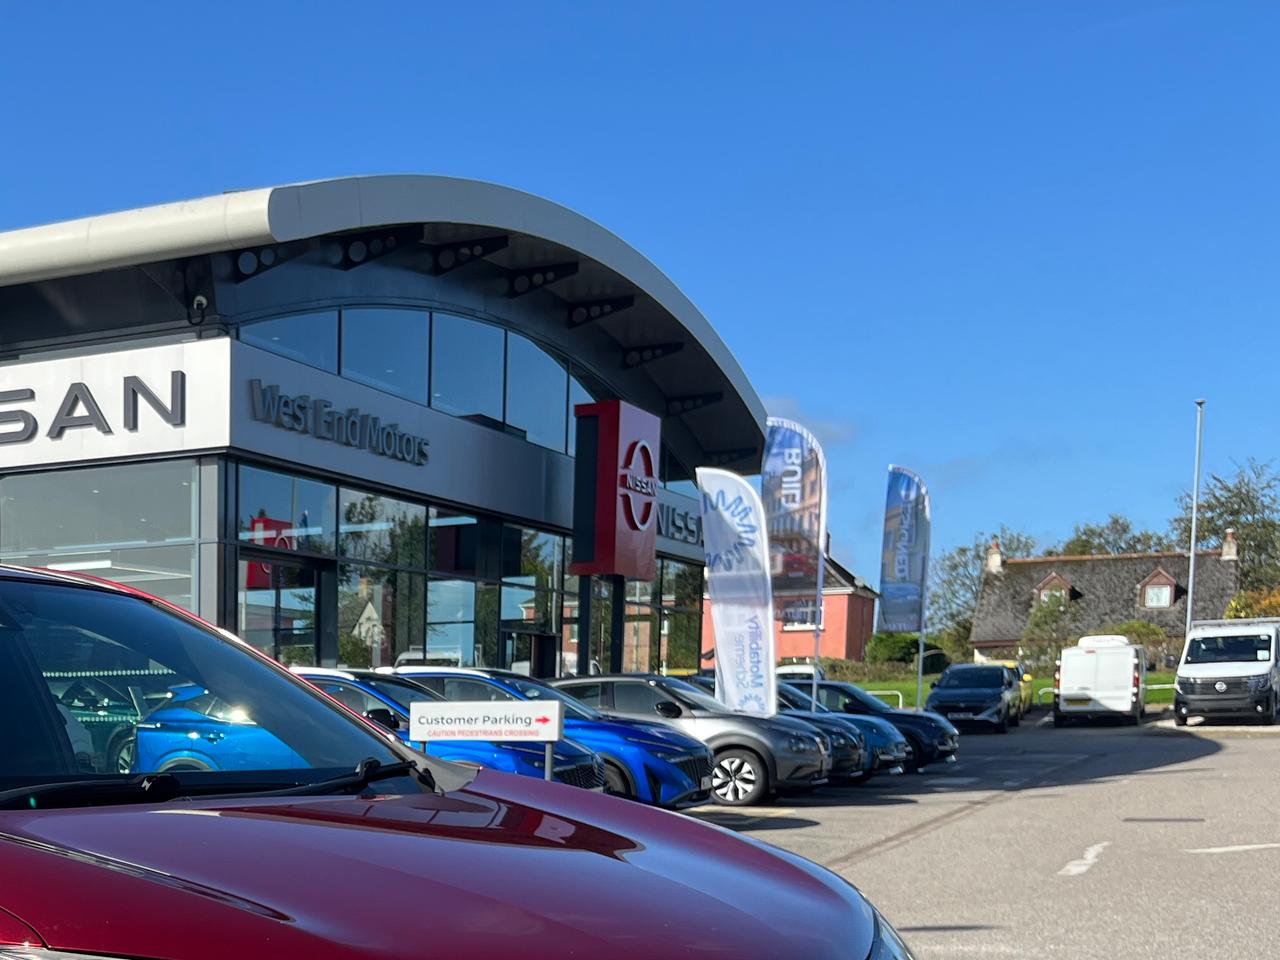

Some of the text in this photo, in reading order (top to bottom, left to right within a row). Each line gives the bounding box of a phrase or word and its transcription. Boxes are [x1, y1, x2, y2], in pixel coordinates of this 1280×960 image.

[249, 378, 430, 467] West End Motors
[626, 474, 658, 497] NISSAN
[417, 713, 532, 727] Customer Parking
[427, 730, 456, 738] CAUTION
